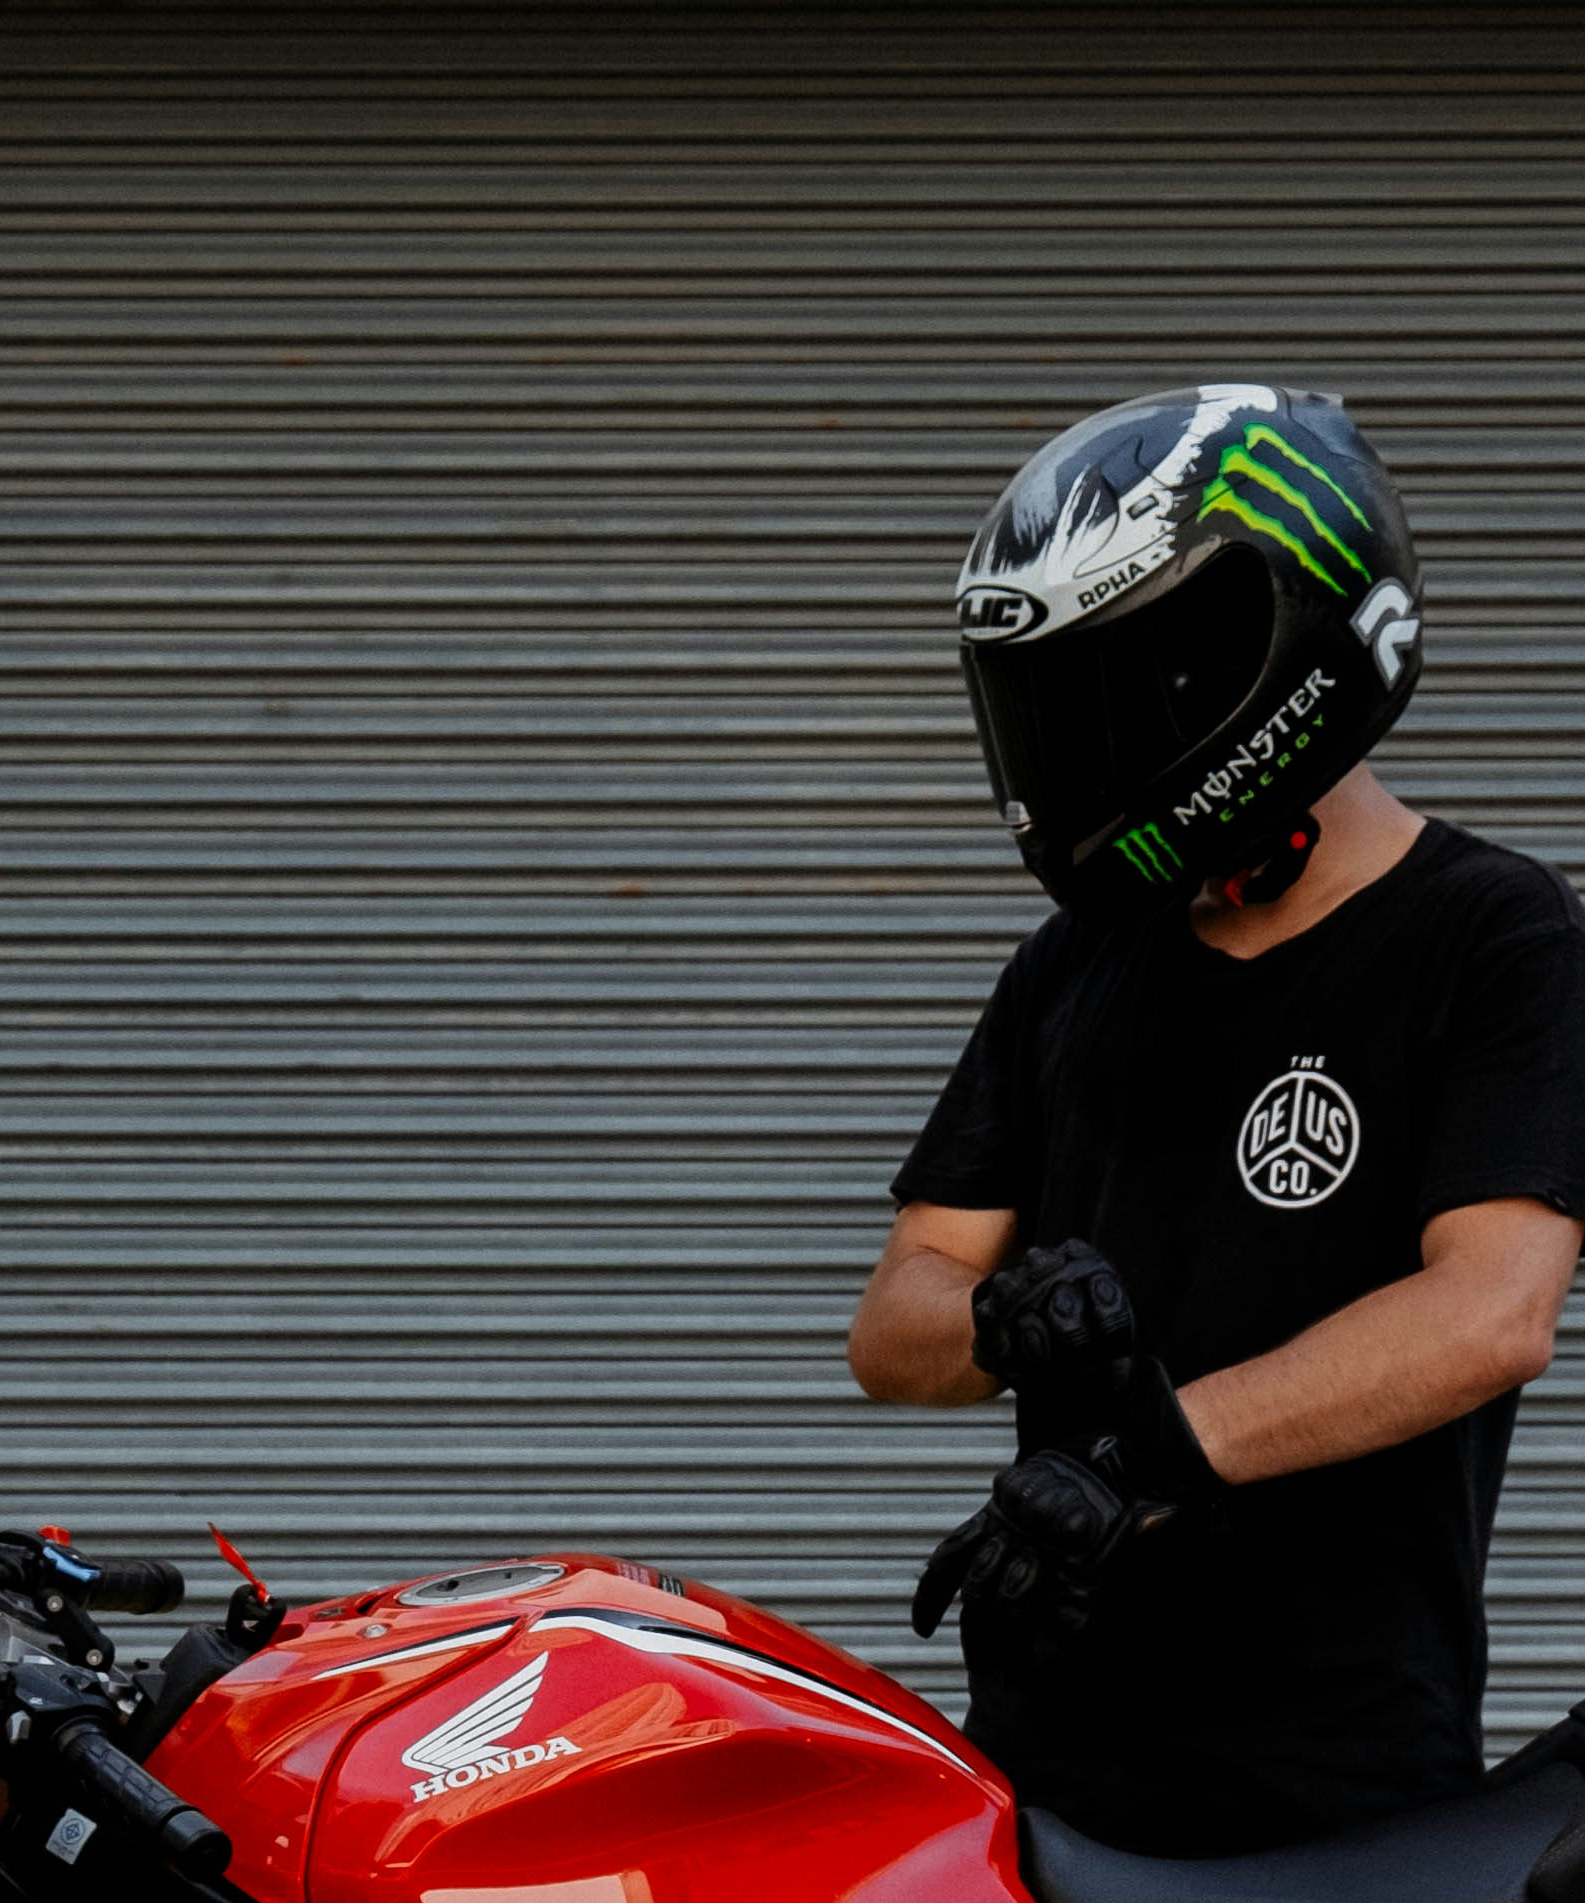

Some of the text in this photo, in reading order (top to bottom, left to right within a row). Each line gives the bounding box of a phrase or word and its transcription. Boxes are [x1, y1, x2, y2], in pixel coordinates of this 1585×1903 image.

[1171, 667, 1337, 827] MONSTER
[1290, 1055, 1326, 1069] THE
[1249, 1090, 1347, 1158] DEUS
[1268, 1159, 1318, 1196] CO.
[409, 1736, 583, 1803] HONDA
